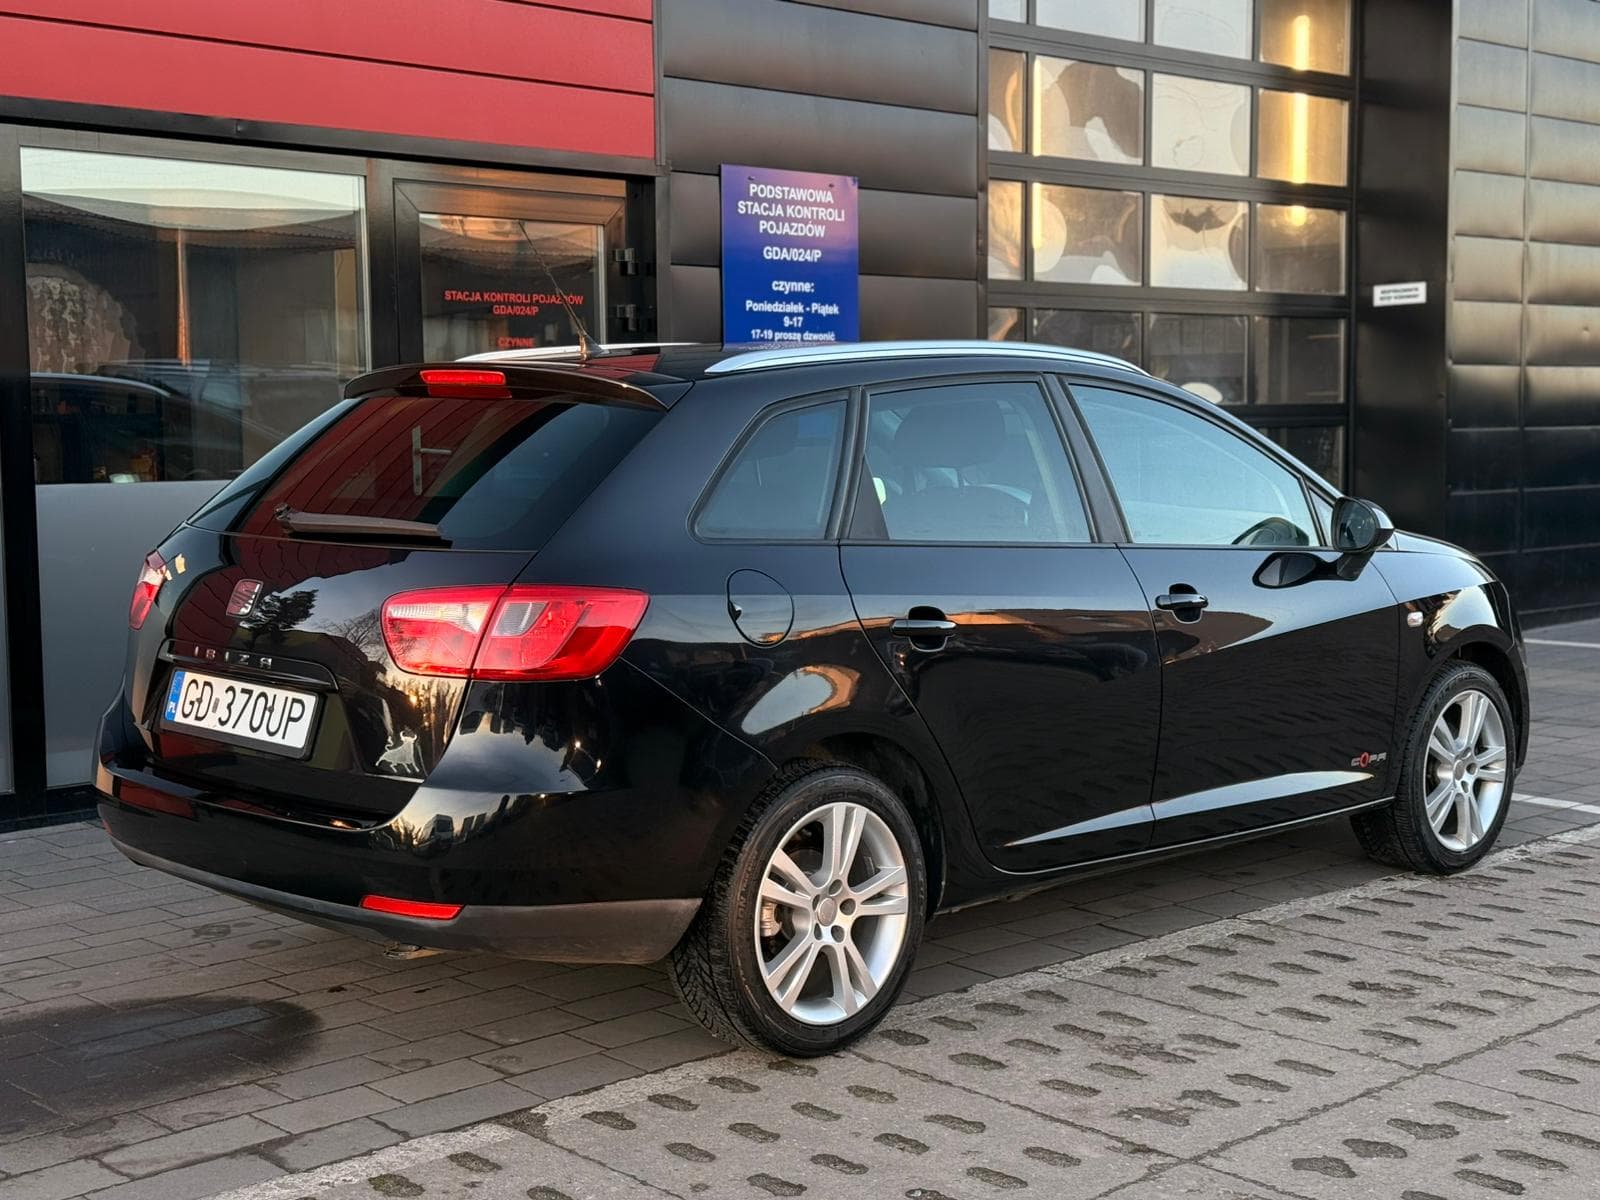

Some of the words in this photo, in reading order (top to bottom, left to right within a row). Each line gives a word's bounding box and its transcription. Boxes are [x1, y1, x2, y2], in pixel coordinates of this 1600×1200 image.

[749, 183, 834, 204] PODSTAWOWA
[737, 200, 784, 217] STACJA
[786, 205, 845, 222] KONTROLI
[759, 219, 826, 237] POJAZDÓW
[763, 246, 822, 262] GDA/024/P
[771, 279, 815, 294] czynne:
[444, 290, 481, 301] STACJA
[484, 292, 531, 303] KONTROLI
[532, 293, 584, 305] POJAZÓW
[493, 304, 540, 316] GDA/024/P
[745, 300, 804, 313] Poniedziałek
[811, 303, 840, 316] Piątek
[783, 316, 804, 328] 9-17
[751, 329, 773, 340] 17-19
[774, 330, 801, 342] proszę
[803, 331, 836, 342] dzwonić
[194, 646, 273, 669] IBIZA
[180, 678, 214, 721] GD
[217, 685, 306, 740] 370UP
